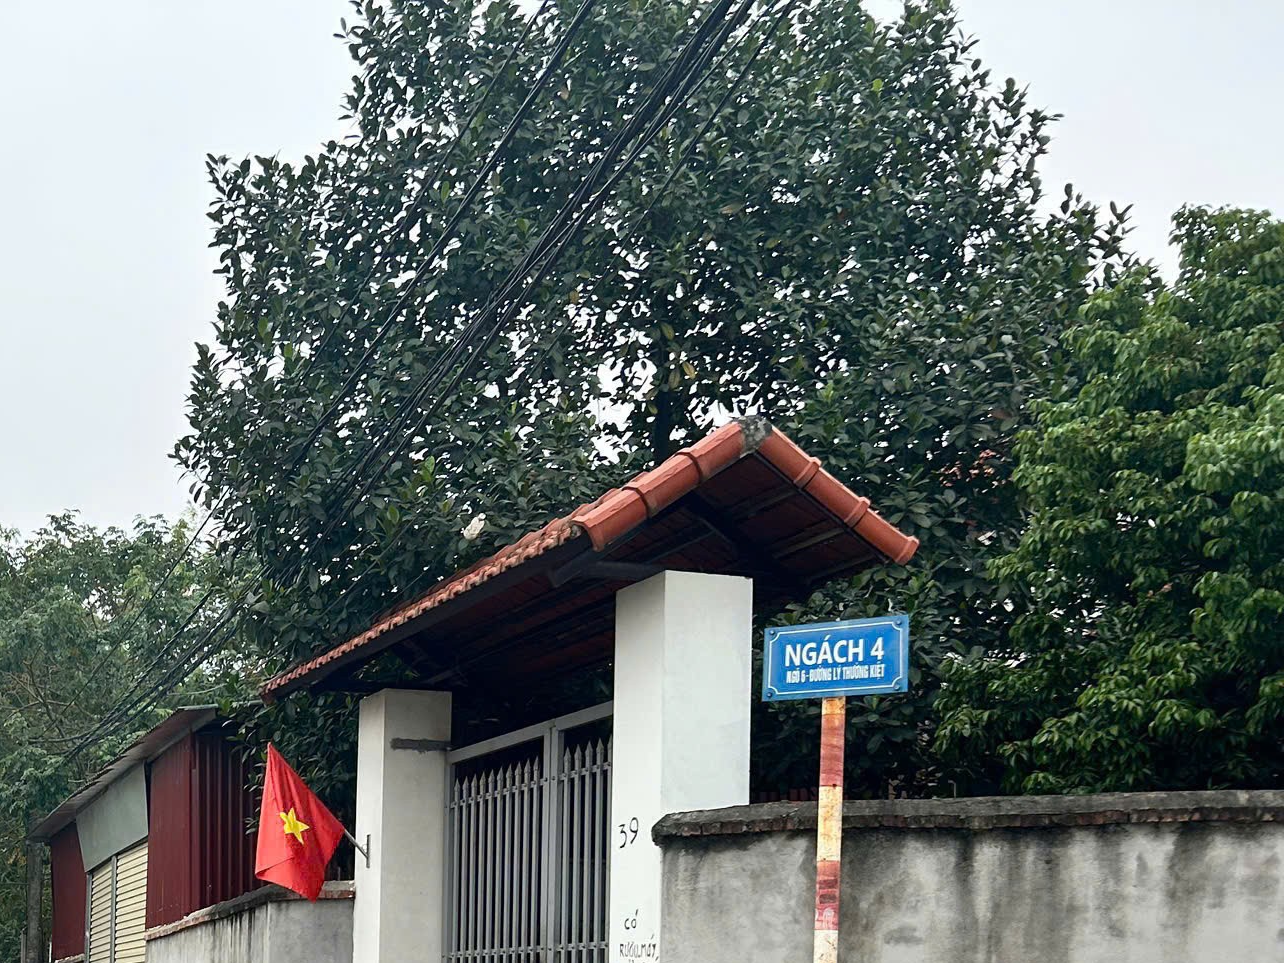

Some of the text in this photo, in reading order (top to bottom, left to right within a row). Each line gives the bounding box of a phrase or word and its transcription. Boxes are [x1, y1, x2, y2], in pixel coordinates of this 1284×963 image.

[785, 635, 885, 667] NGÁCH 4
[833, 664, 842, 680] LÝ
[618, 817, 639, 849] 39
